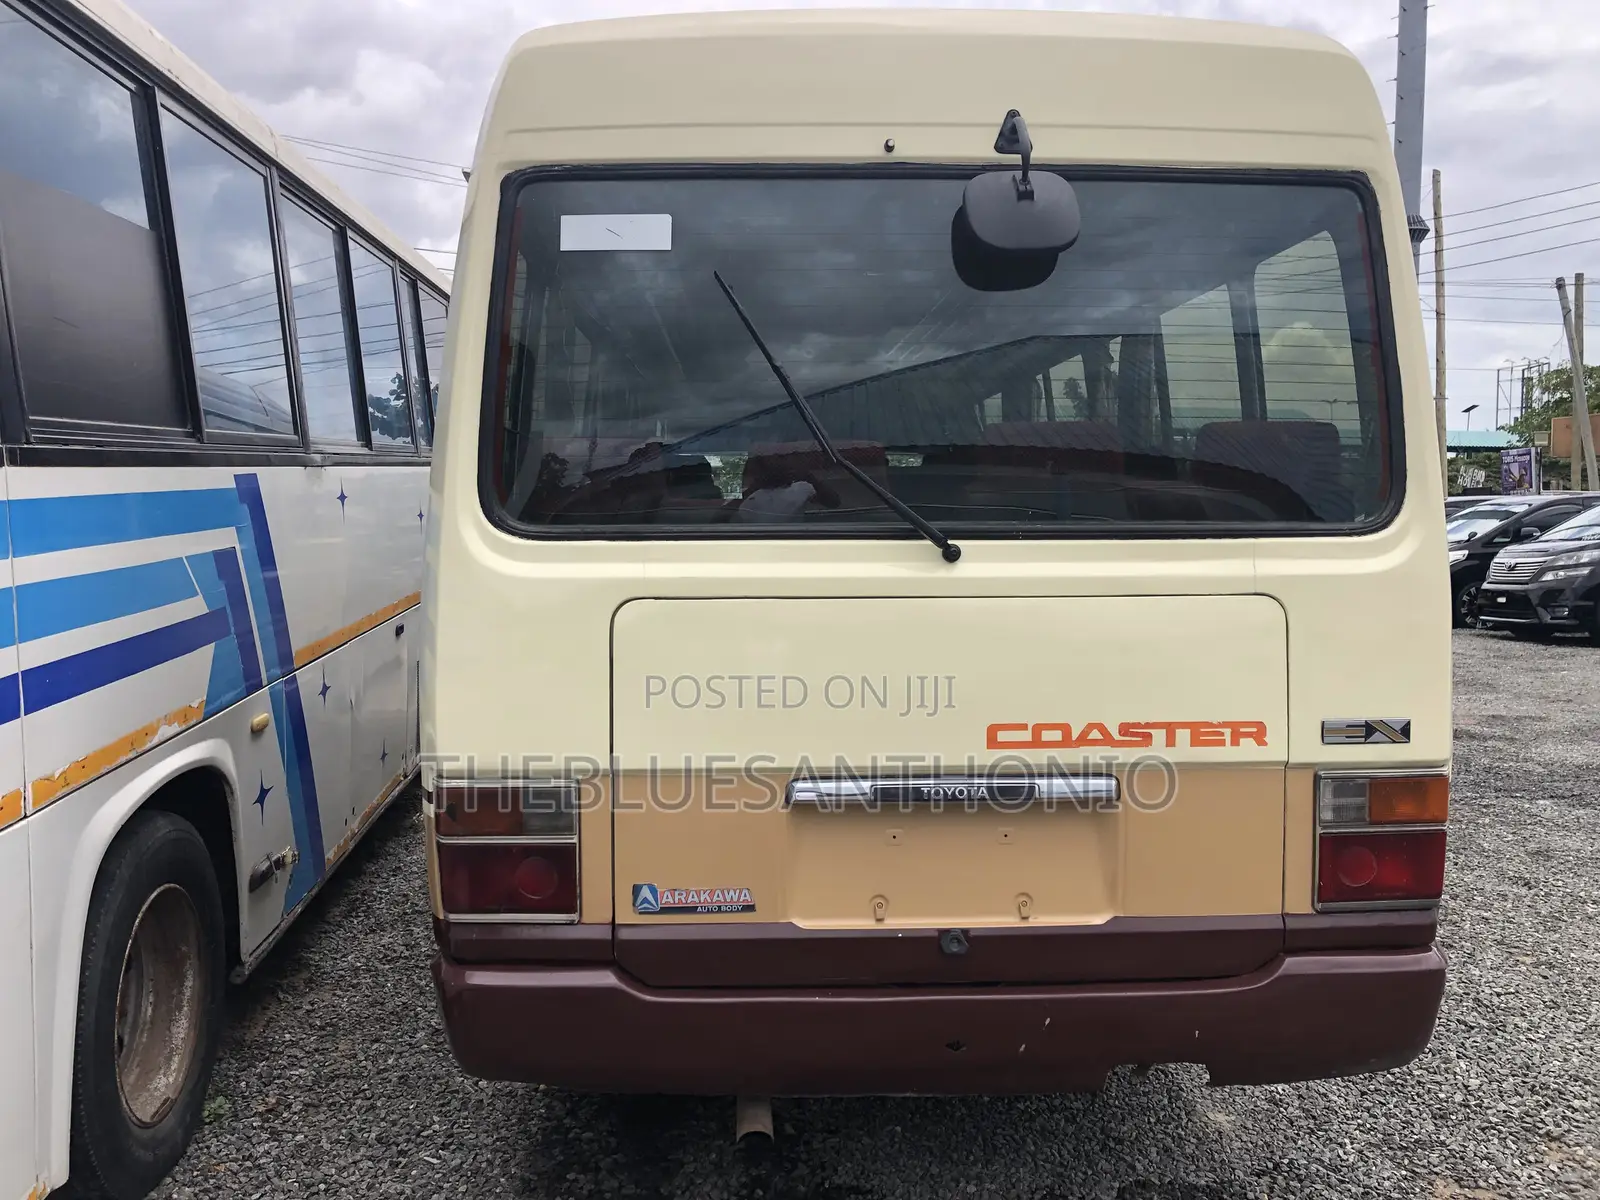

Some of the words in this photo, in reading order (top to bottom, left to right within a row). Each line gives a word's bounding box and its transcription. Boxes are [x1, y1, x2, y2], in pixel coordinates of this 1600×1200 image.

[986, 720, 1269, 750] COASTER
[920, 786, 990, 800] TOYOTA
[661, 887, 752, 904] ARAKAWA
[696, 904, 719, 913] AUTO
[720, 904, 743, 912] BODY
